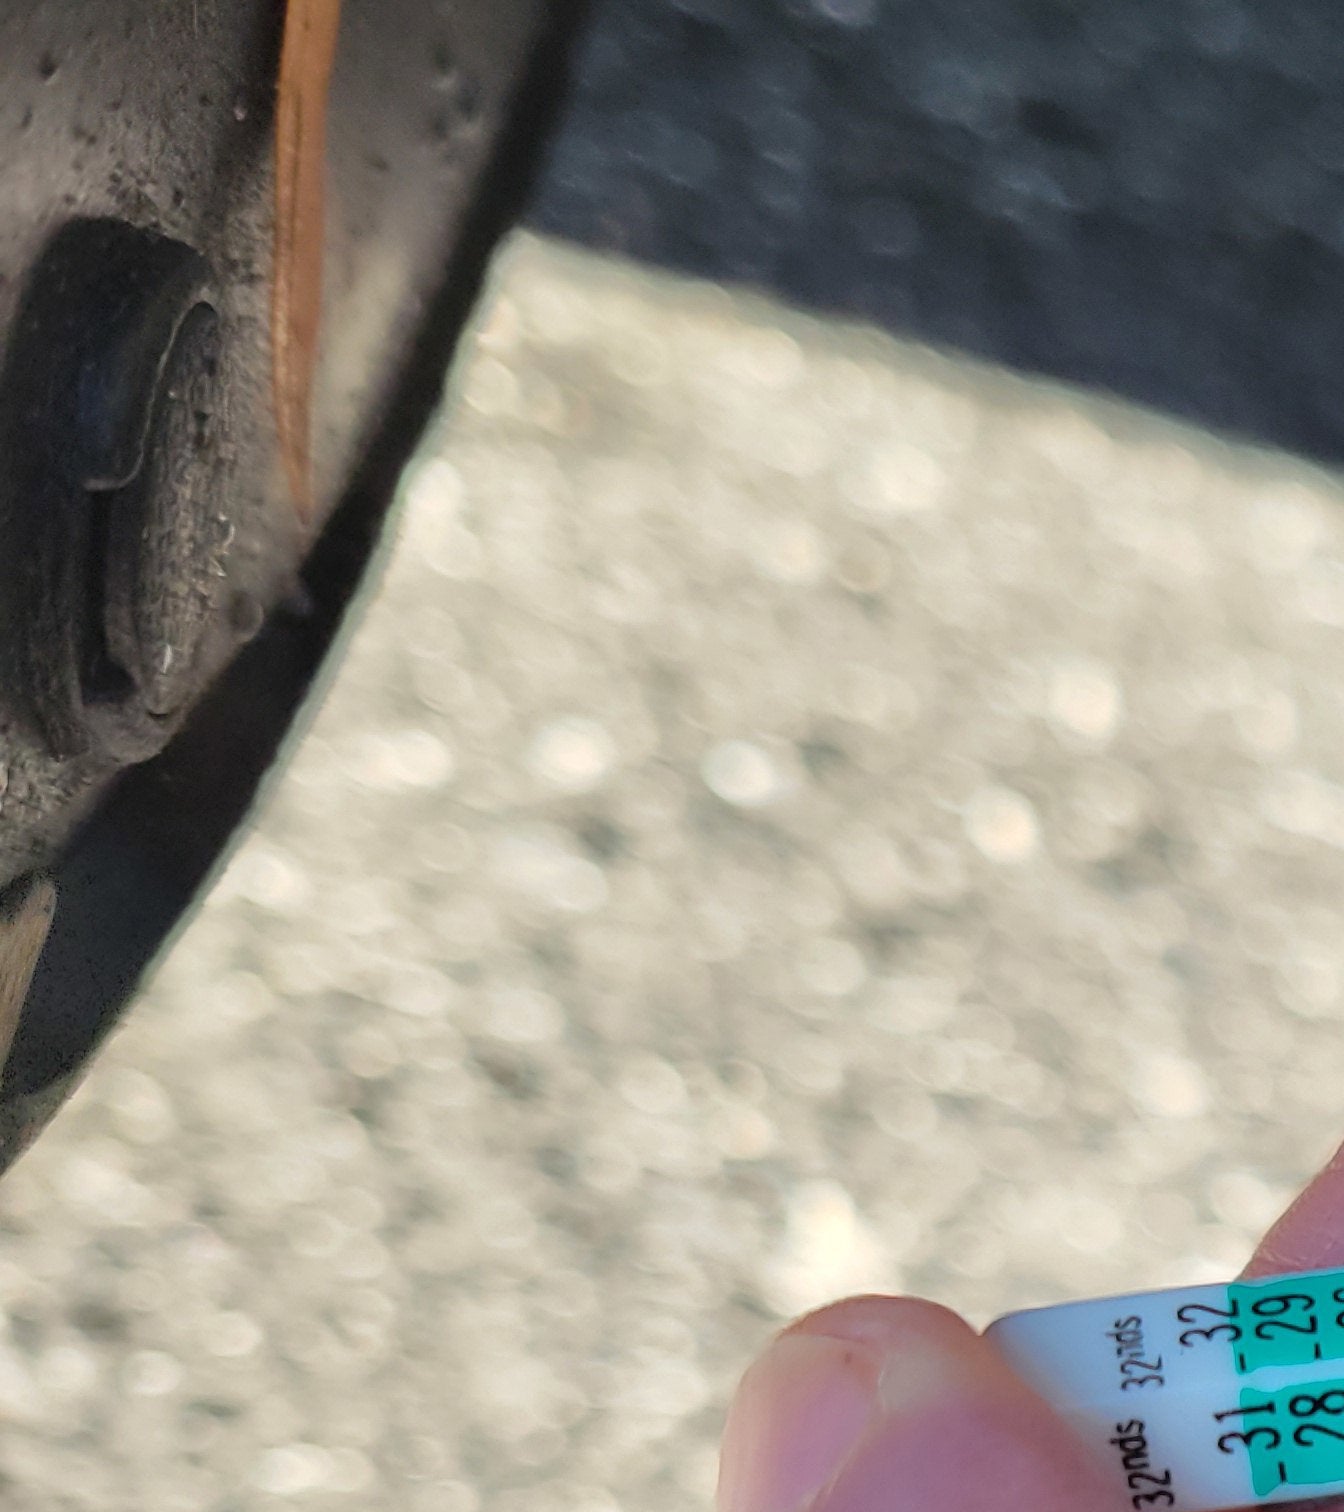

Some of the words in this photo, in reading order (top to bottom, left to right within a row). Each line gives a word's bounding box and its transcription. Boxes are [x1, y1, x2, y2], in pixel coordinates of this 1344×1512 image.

[1178, 1298, 1242, 1348] 32
[1252, 1293, 1317, 1340] 29
[1106, 1315, 1164, 1391] 32nds
[1213, 1401, 1279, 1455] 31
[1110, 1419, 1175, 1510] 32nds
